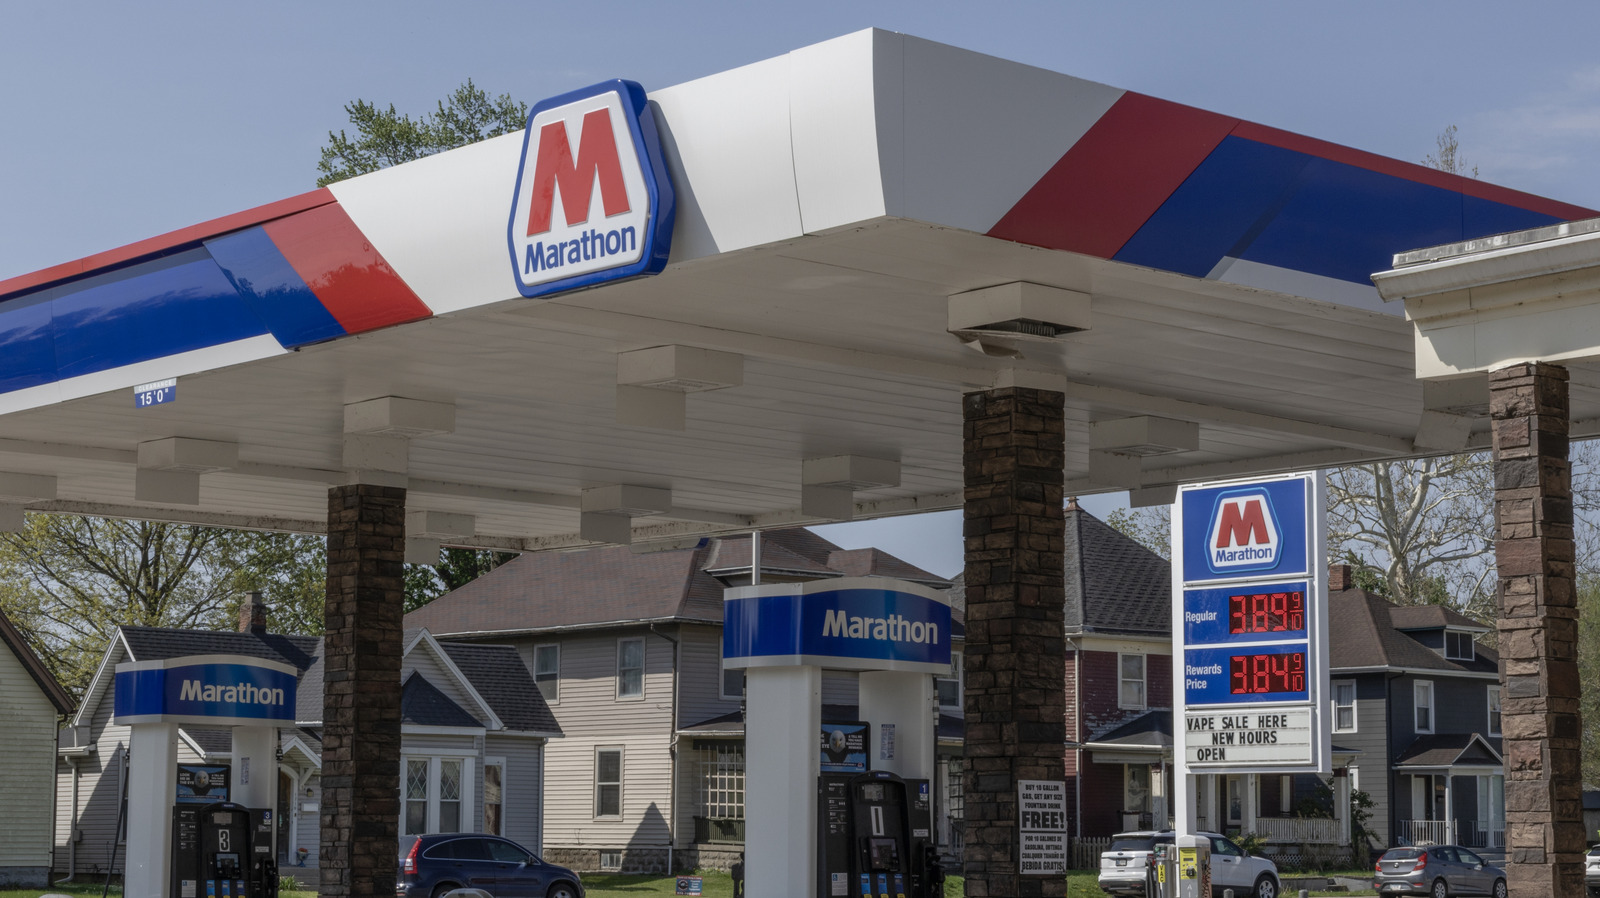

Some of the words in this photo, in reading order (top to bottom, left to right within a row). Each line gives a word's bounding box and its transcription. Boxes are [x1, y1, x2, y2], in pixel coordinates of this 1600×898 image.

[527, 106, 631, 237] M
[524, 225, 636, 275] Marathon
[1216, 499, 1270, 549] M
[1215, 547, 1272, 563] Marathon
[1185, 610, 1218, 624] Regular
[1231, 593, 1288, 634] 3.89
[822, 609, 938, 645] Marathon
[1186, 663, 1222, 676] Rewards
[1231, 654, 1289, 694] 3.84
[179, 679, 284, 706] Marathon
[1186, 678, 1207, 690] Price
[1187, 717, 1214, 730] VAPE
[1222, 716, 1248, 729] SALE
[1258, 715, 1287, 728] HERE
[1212, 732, 1234, 745] NEW
[1239, 731, 1277, 744] HOURS
[1197, 748, 1226, 761] OPEN
[265, 811, 270, 819] 3
[1021, 811, 1065, 829] FREE!
[220, 830, 229, 851] 3
[1022, 861, 1041, 870] BEBIDA
